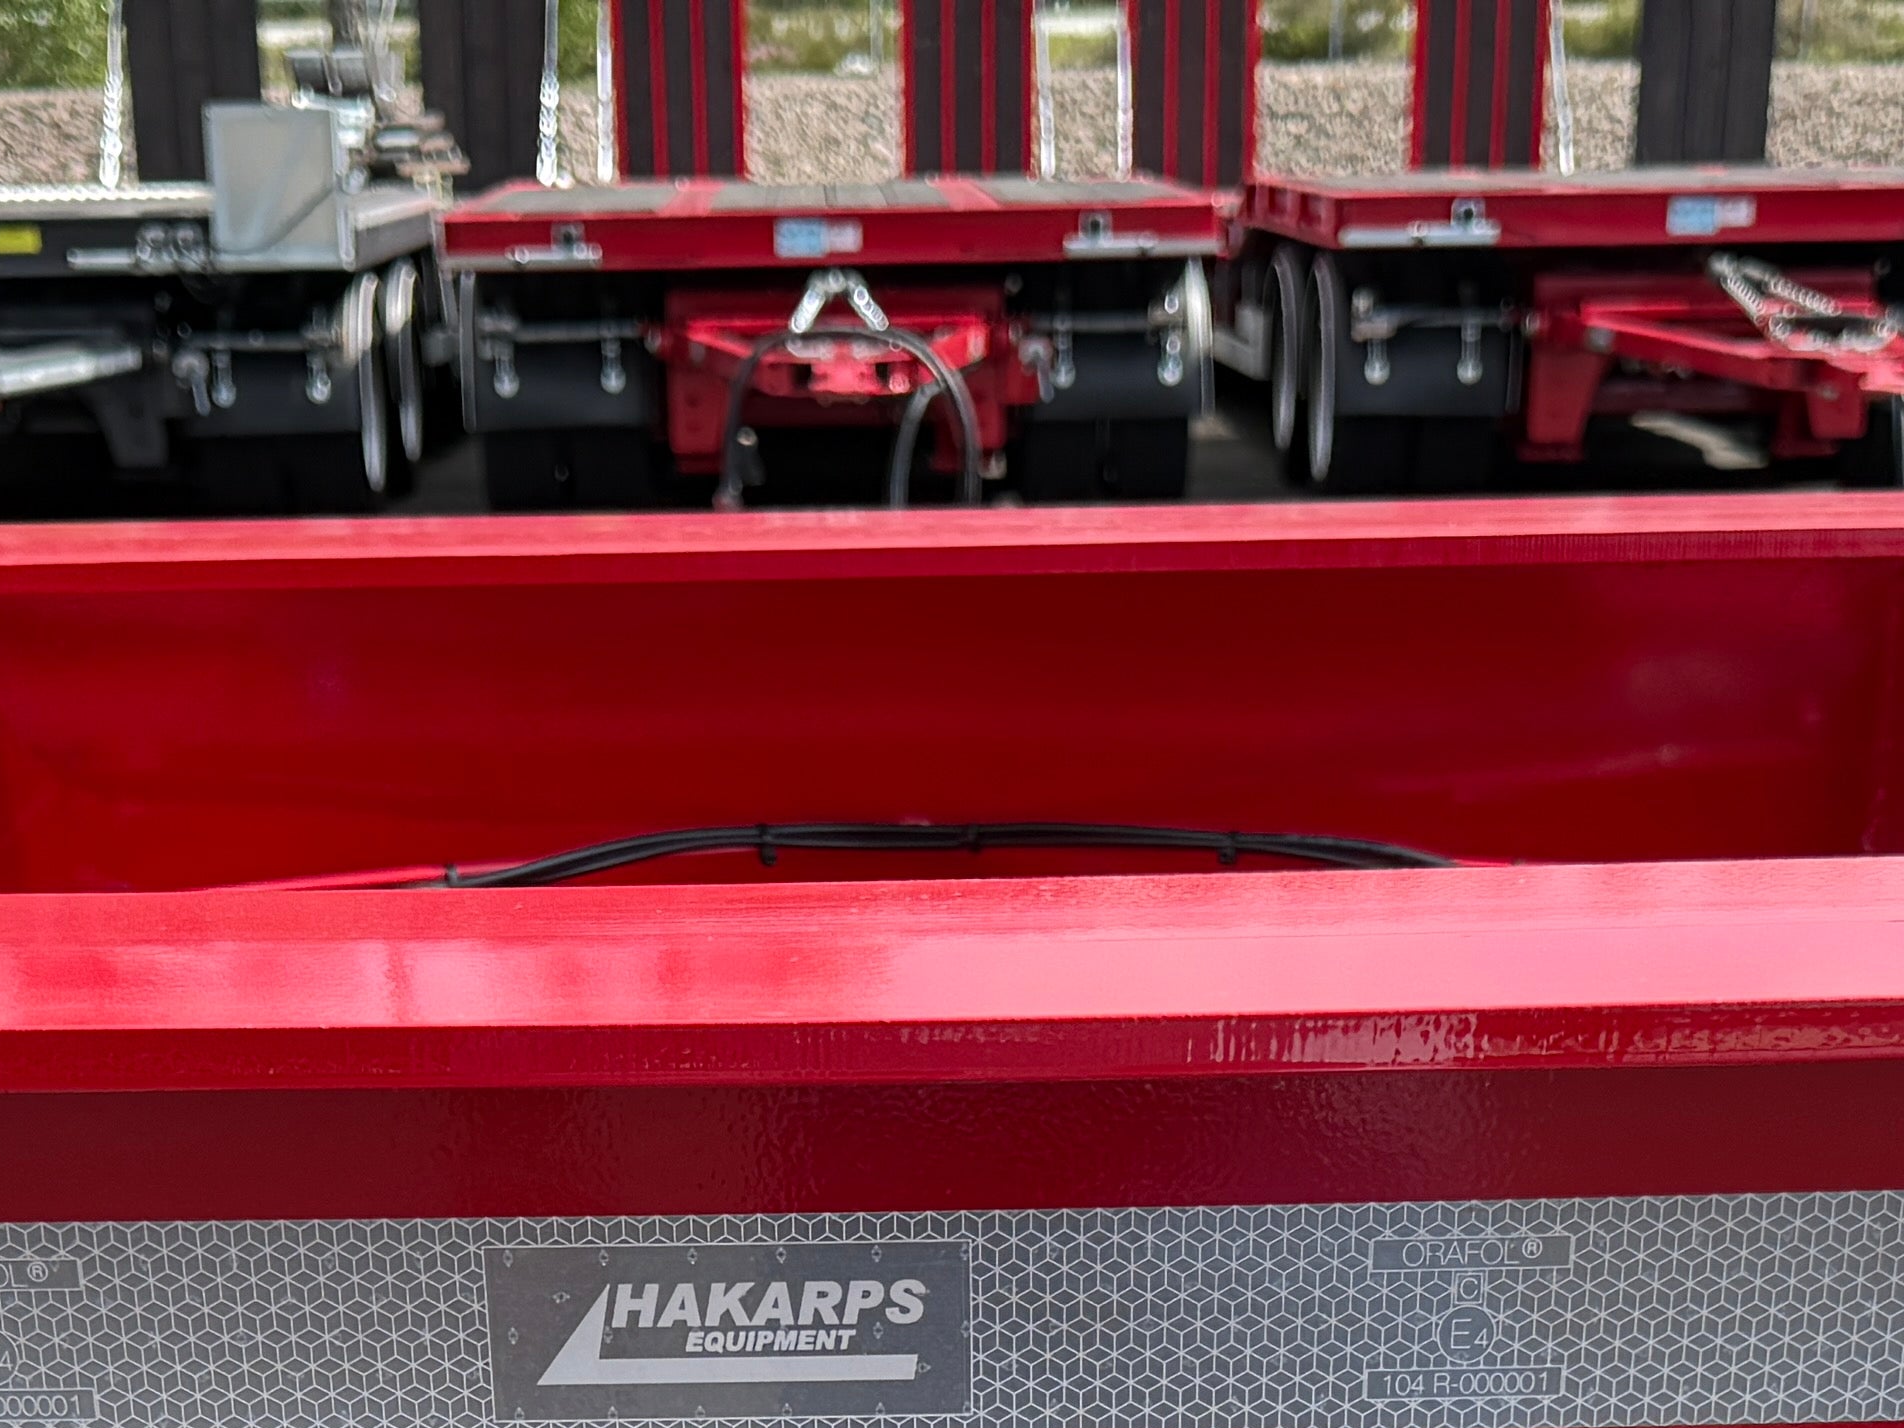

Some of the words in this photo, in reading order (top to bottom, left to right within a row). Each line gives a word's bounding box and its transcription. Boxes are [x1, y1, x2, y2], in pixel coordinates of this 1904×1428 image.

[1459, 1277, 1479, 1300] C
[611, 1278, 928, 1328] HAKARPS
[684, 1328, 857, 1354] EQUIPMENT
[1383, 1373, 1425, 1396] 104
[1432, 1371, 1549, 1395] R-000001
